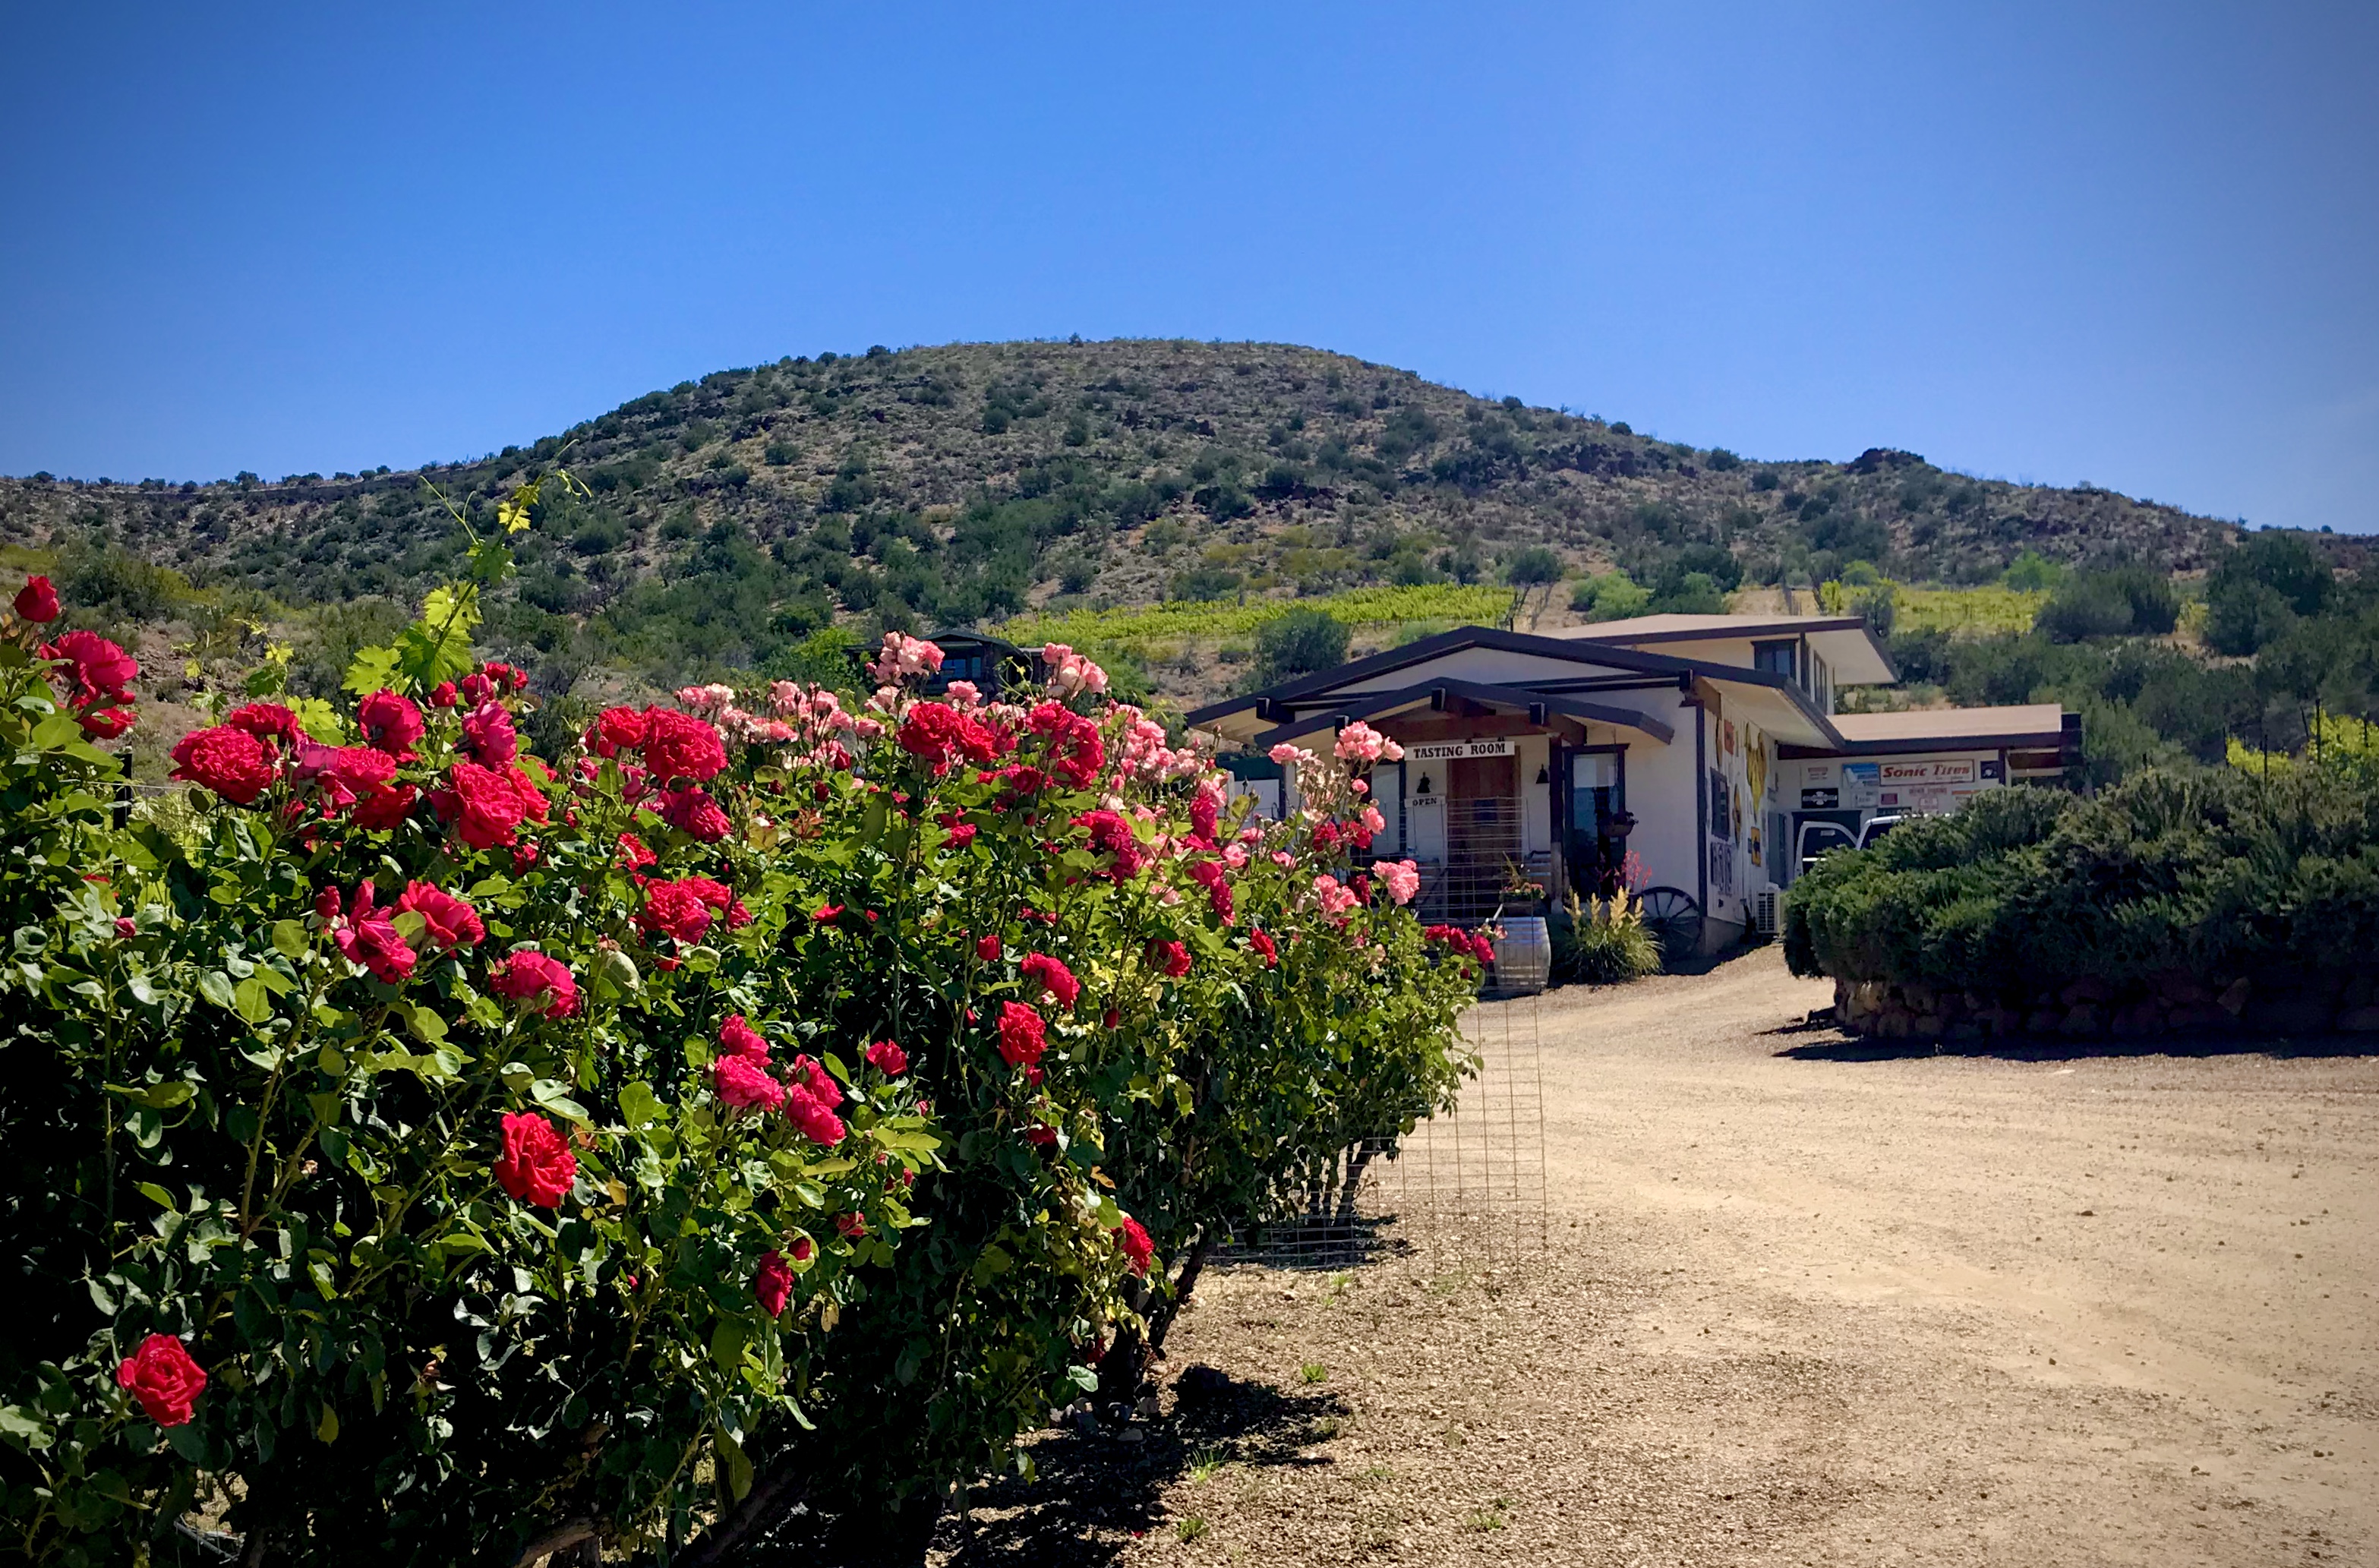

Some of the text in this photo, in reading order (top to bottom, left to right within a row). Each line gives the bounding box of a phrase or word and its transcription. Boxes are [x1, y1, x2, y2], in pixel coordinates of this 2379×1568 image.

[1413, 743, 1505, 758] TASTING ROOM
[1883, 767, 1927, 778] Sonic
[1412, 798, 1437, 806] OPEN
